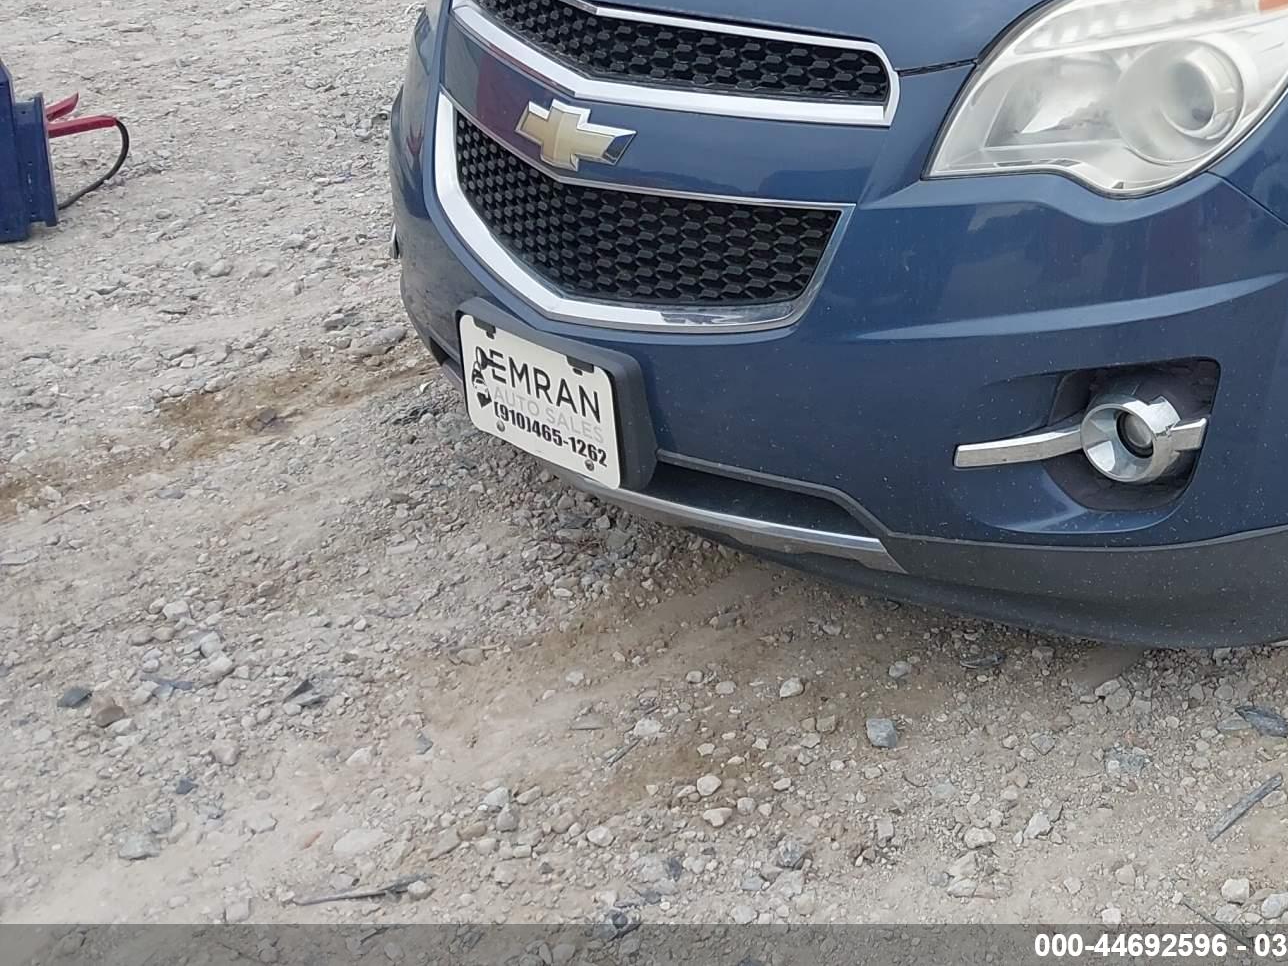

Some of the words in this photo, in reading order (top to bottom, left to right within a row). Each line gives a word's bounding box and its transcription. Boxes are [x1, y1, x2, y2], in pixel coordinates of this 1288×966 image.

[488, 348, 602, 424] EMRAN
[493, 387, 540, 416] AUTO
[546, 403, 604, 444] SALES
[493, 401, 608, 468] (910)465-1262
